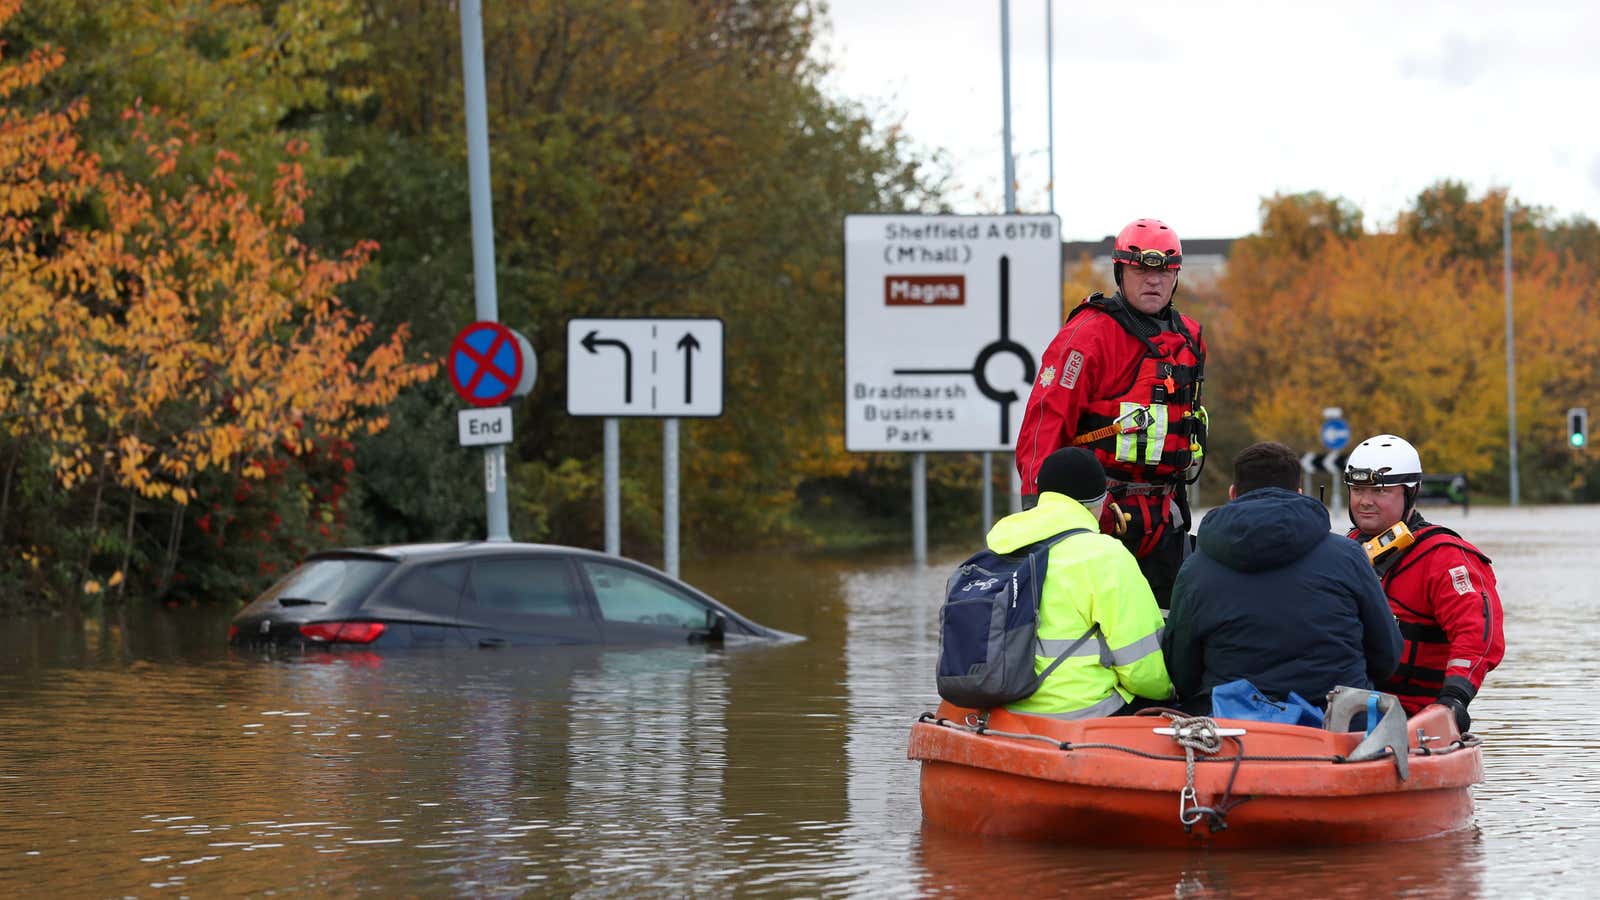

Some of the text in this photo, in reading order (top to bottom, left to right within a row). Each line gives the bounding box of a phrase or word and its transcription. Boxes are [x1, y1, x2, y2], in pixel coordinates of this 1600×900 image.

[885, 223, 979, 239] Sheffield
[883, 245, 972, 264] (M'hall)
[890, 280, 961, 303] Magna
[853, 383, 966, 400] Bradmarsh
[864, 405, 955, 421] Business
[468, 418, 503, 436] End
[885, 427, 932, 442] Park
